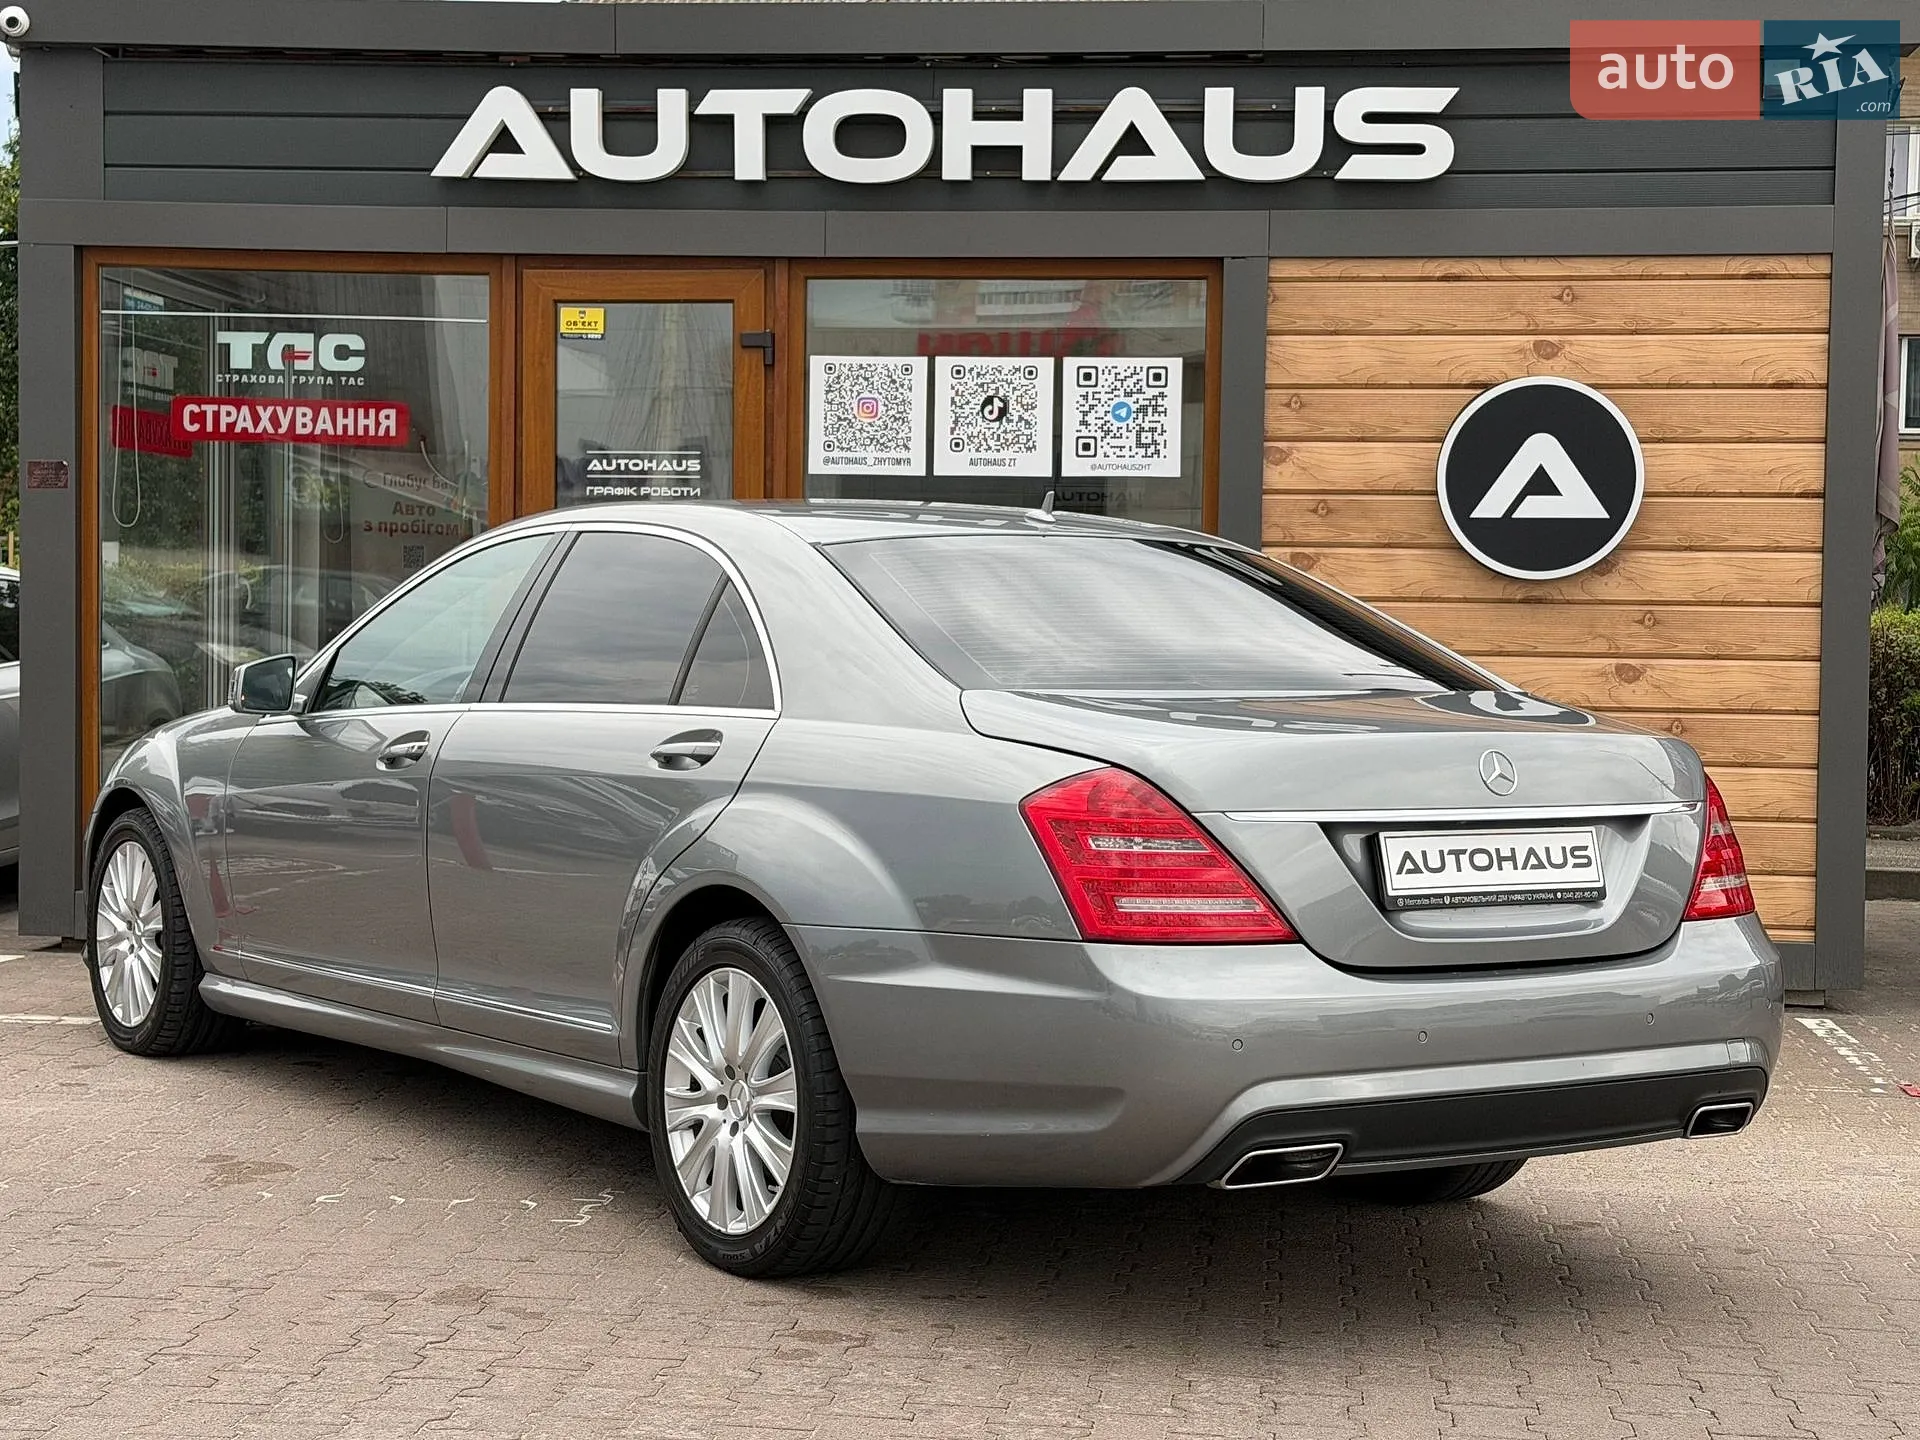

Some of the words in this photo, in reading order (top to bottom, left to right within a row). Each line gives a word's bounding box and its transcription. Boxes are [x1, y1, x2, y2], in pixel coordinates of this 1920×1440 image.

[430, 85, 1460, 183] AUTOHAUS
[216, 374, 284, 384] СТРАХОВА
[291, 376, 334, 386] ГРУПА
[340, 377, 365, 386] ТАС
[183, 403, 397, 437] СТРАХУВАННЯ
[587, 459, 701, 471] AUTOHAUS
[968, 458, 1007, 467] AUTOHAUS
[1007, 459, 1017, 467] ZT
[586, 486, 637, 496] ГРАФІК
[640, 486, 701, 497] РОБОТИ
[392, 501, 437, 517] Авто
[363, 520, 373, 532] з
[378, 519, 459, 537] пробігом
[1396, 845, 1593, 875] AUTOHAUS
